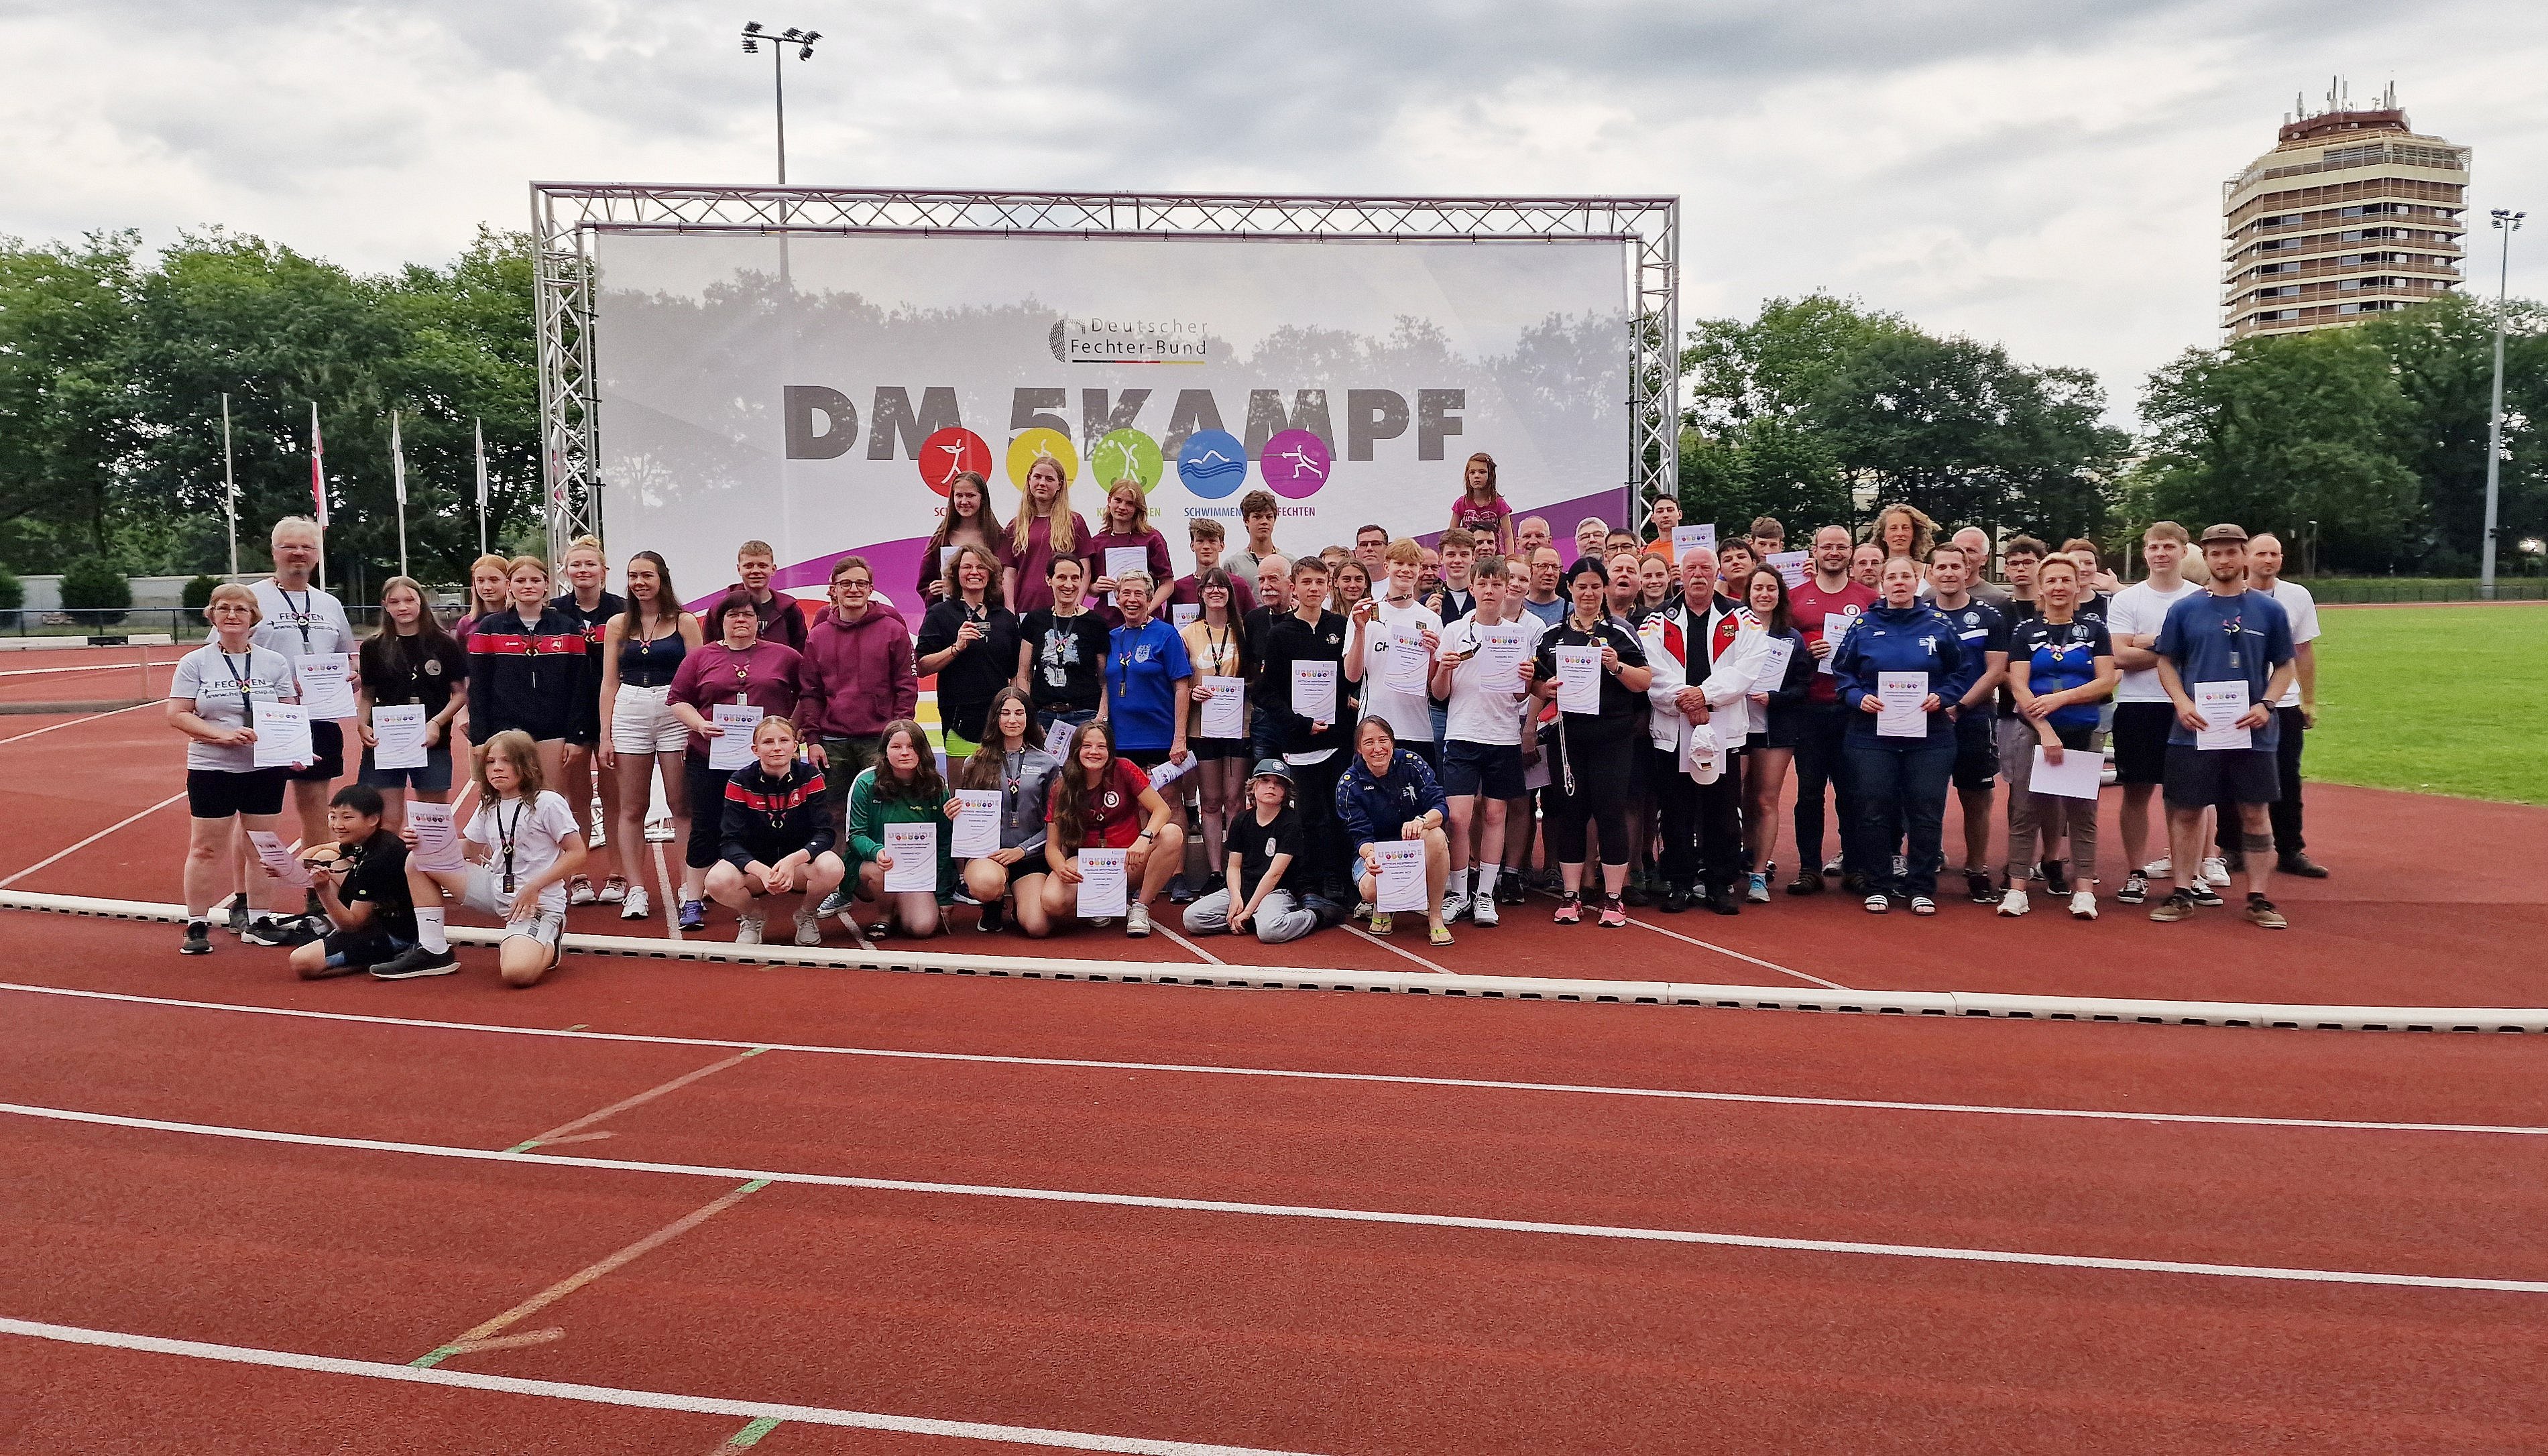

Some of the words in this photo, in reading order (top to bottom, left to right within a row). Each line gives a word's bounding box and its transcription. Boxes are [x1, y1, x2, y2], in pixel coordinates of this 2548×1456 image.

[1092, 318, 1207, 332] Deutscher
[1071, 339, 1206, 355] Fechter-Bund
[783, 385, 963, 461] DM
[1008, 387, 1466, 461] 5KAMPF
[1184, 507, 1242, 517] SCHWIMMEN
[1277, 507, 1316, 516] FECHTEN
[280, 613, 325, 621] FECEN
[215, 678, 266, 688] FECEN
